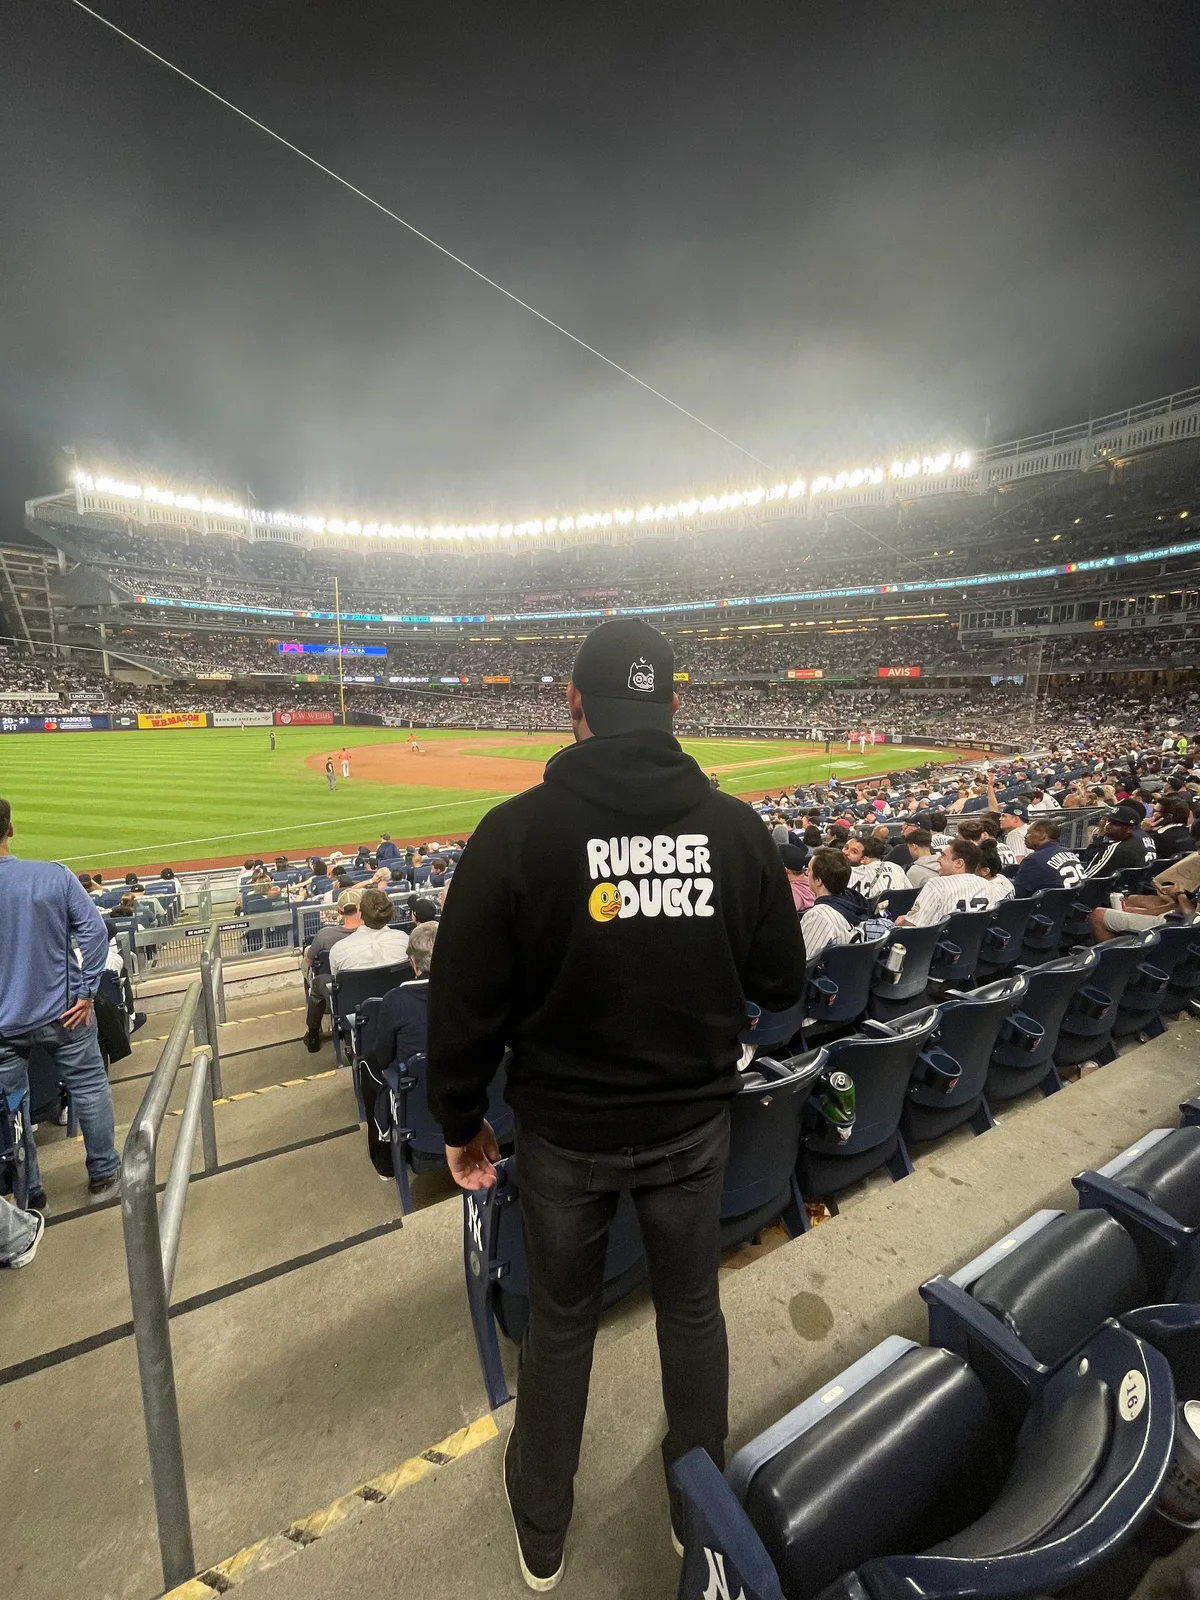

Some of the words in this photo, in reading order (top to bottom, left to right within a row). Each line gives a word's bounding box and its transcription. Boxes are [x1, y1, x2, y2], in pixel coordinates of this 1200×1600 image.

[1139, 552, 1154, 560] with
[1154, 550, 1169, 558] your
[1078, 562, 1089, 570] Tap
[937, 579, 967, 588] Mastercard
[587, 834, 711, 880] RUBBER
[617, 878, 715, 919] DUCKZ
[1126, 1383, 1138, 1409] 16
